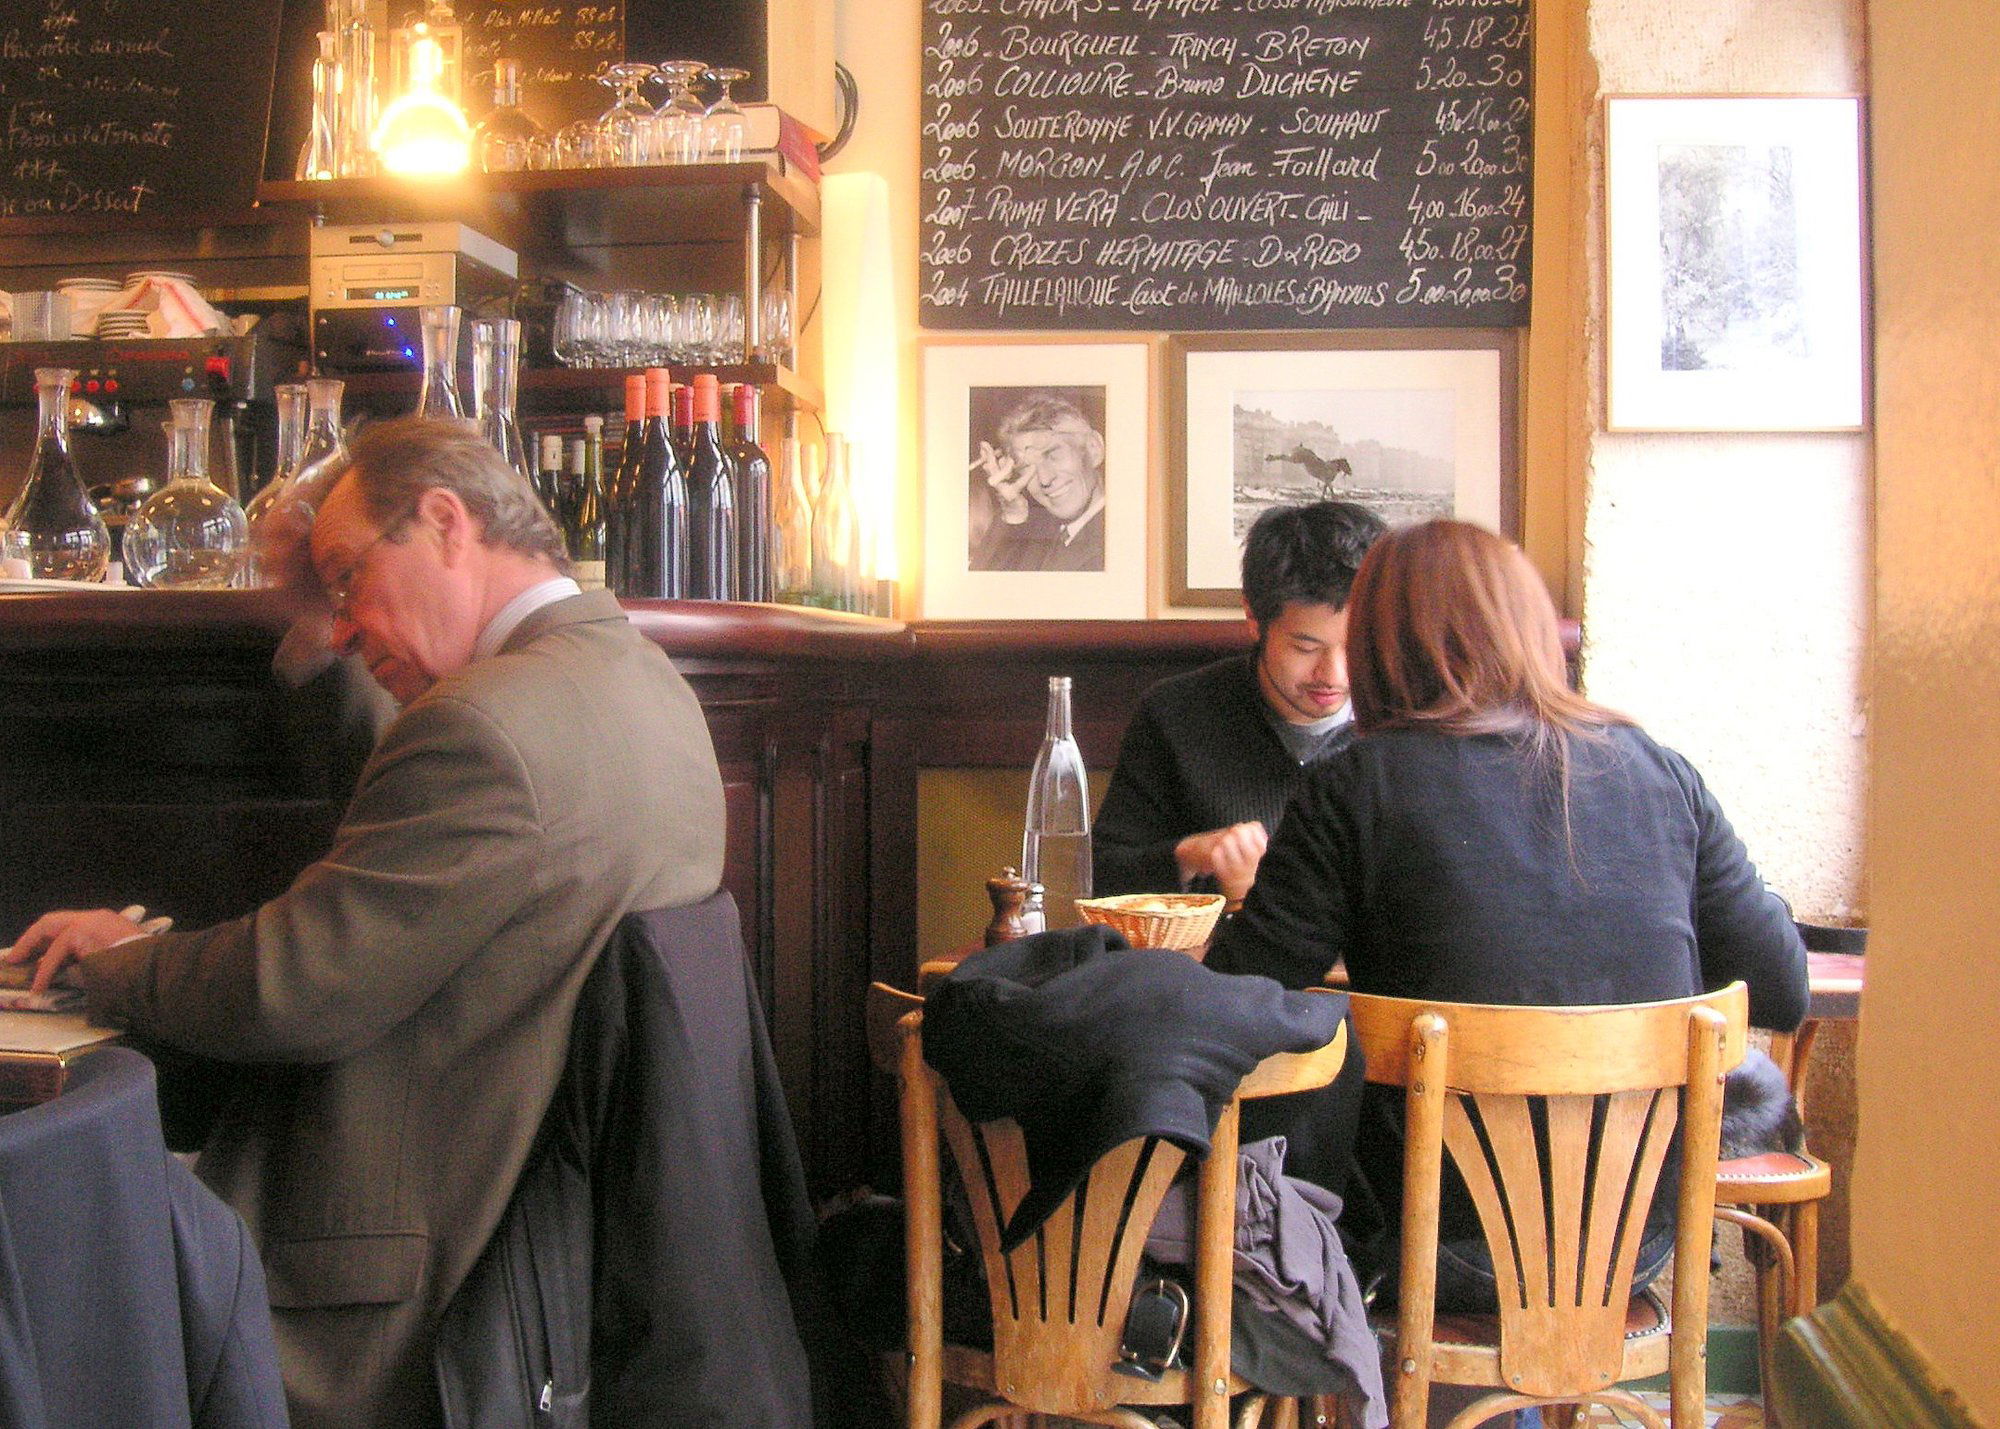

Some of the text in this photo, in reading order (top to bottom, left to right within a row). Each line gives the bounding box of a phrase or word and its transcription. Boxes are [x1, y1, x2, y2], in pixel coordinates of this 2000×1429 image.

[925, 22, 982, 59] 2006
[999, 25, 1140, 65] BOURGUEIL
[1167, 33, 1237, 70] TRINCH
[1255, 25, 1370, 66] BRETON
[926, 59, 984, 98] 2006
[1155, 66, 1224, 99] Bruno
[1237, 62, 1362, 99] DUCHENE
[923, 102, 982, 142] 2006
[994, 105, 1133, 144] SOUTERONNE
[1280, 107, 1391, 141] SOUHAUT
[922, 146, 979, 183] 2006
[996, 147, 1106, 184] MORGON
[1200, 144, 1258, 196] Jean
[1273, 146, 1382, 182] Foillard
[922, 230, 973, 266] 2006
[990, 232, 1091, 272] CROZES
[1097, 234, 1238, 275] HERMITAGE
[921, 270, 969, 307] 2004
